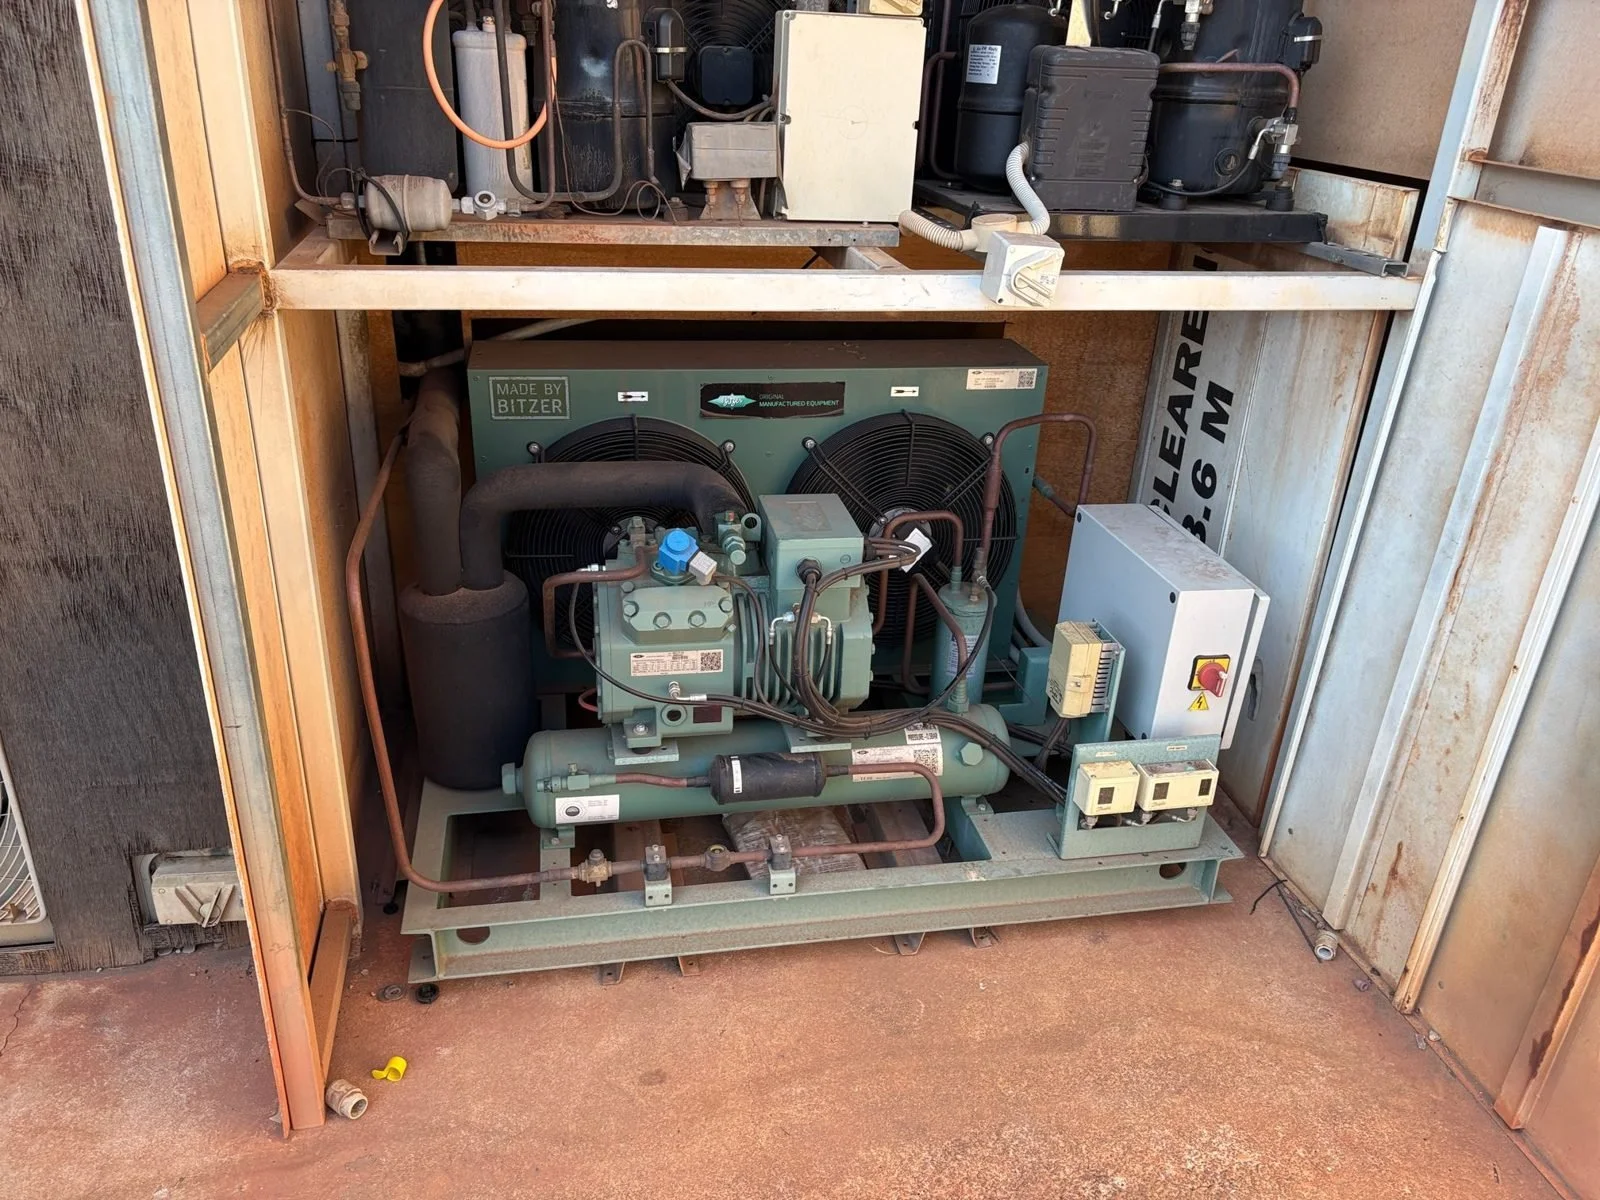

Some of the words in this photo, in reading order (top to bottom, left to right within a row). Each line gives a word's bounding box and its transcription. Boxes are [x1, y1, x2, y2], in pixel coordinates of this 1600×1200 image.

[496, 383, 538, 395] MADE
[544, 383, 563, 395] BY
[498, 399, 563, 414] BITZER
[1181, 458, 1217, 544] 3.6
[1200, 380, 1234, 444] M
